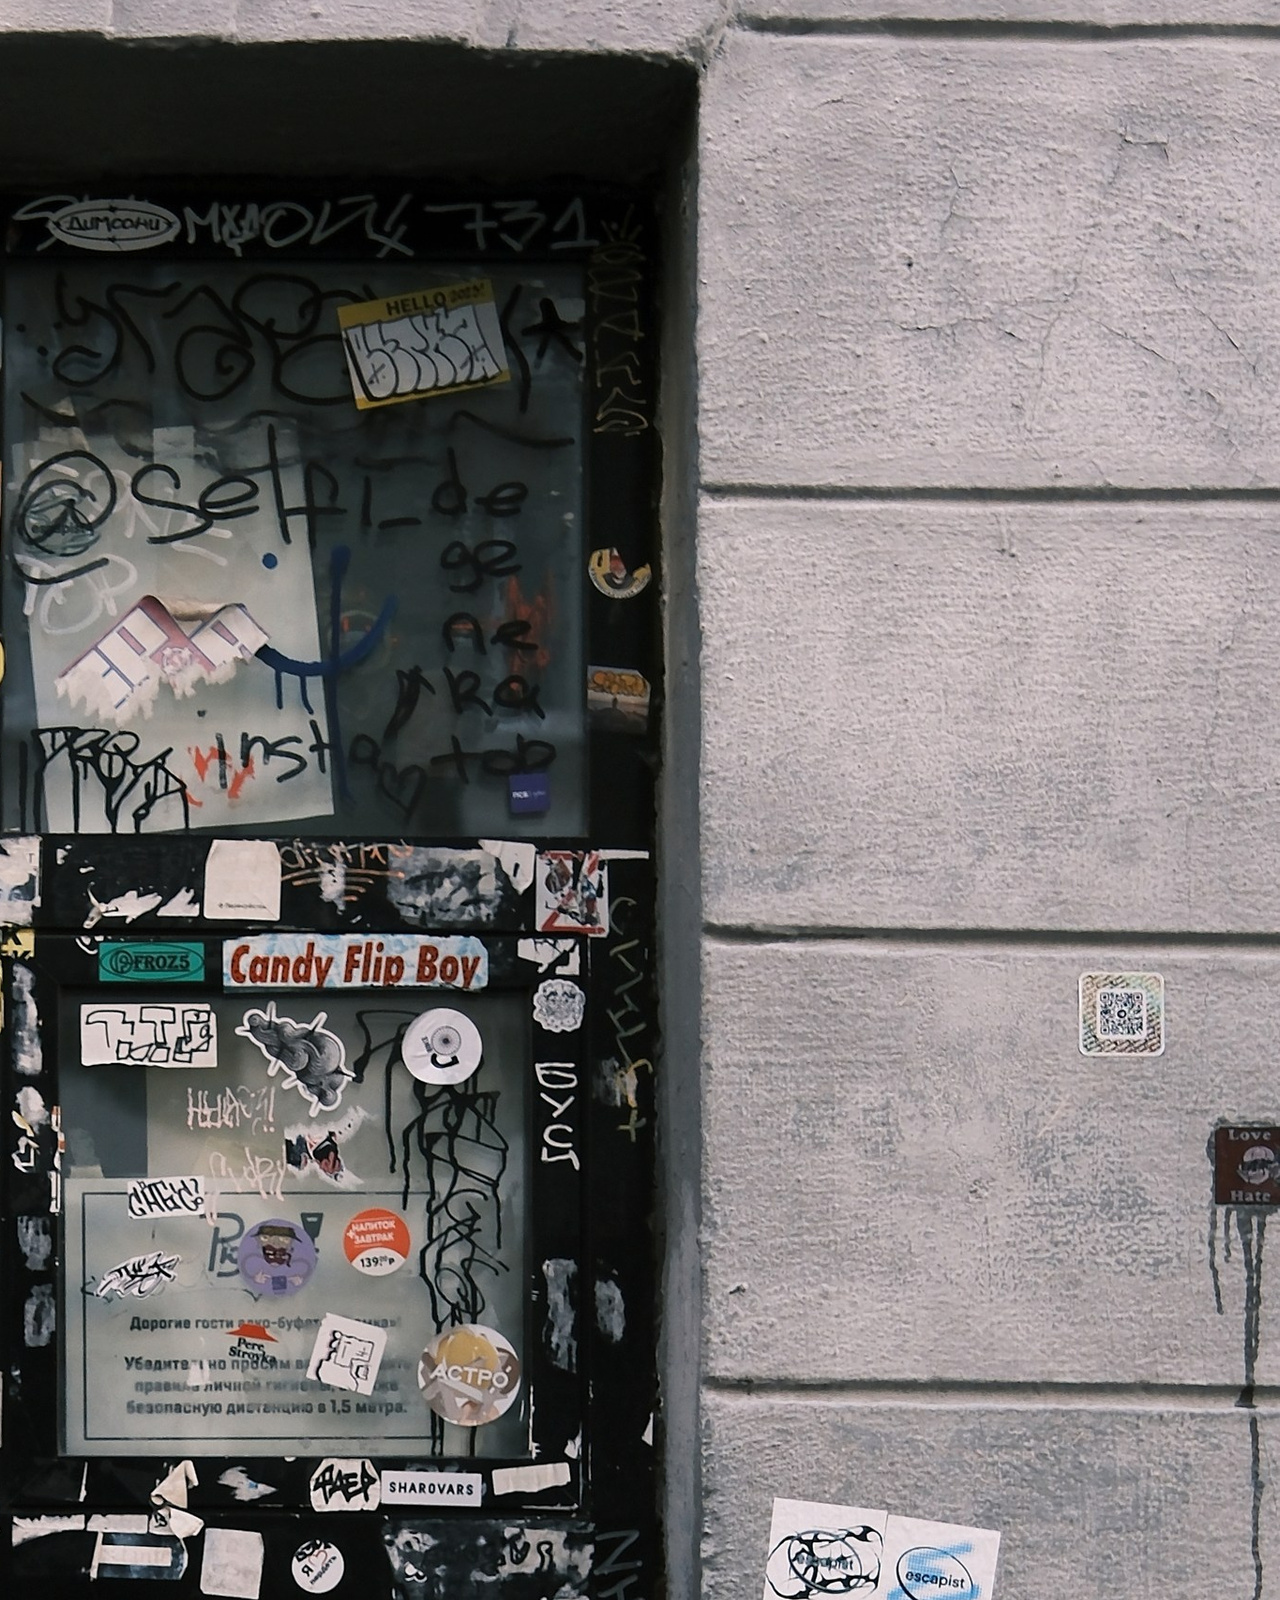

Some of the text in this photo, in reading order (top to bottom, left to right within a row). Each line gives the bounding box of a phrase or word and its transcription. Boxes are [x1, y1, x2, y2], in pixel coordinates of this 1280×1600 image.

[230, 941, 482, 989] Candy Flip Boy
[1228, 1128, 1272, 1141] Love
[1230, 1189, 1271, 1202] Hate
[129, 1316, 191, 1332] Дорогие
[194, 1317, 234, 1330] гости
[236, 1336, 265, 1352] Pere
[126, 1400, 222, 1416] безопасную
[225, 1400, 313, 1416] дистанцию
[330, 1399, 352, 1415] 1,5
[355, 1401, 408, 1416] метра.
[388, 1481, 475, 1496] SHAROVARS
[905, 1569, 966, 1589] escapist
